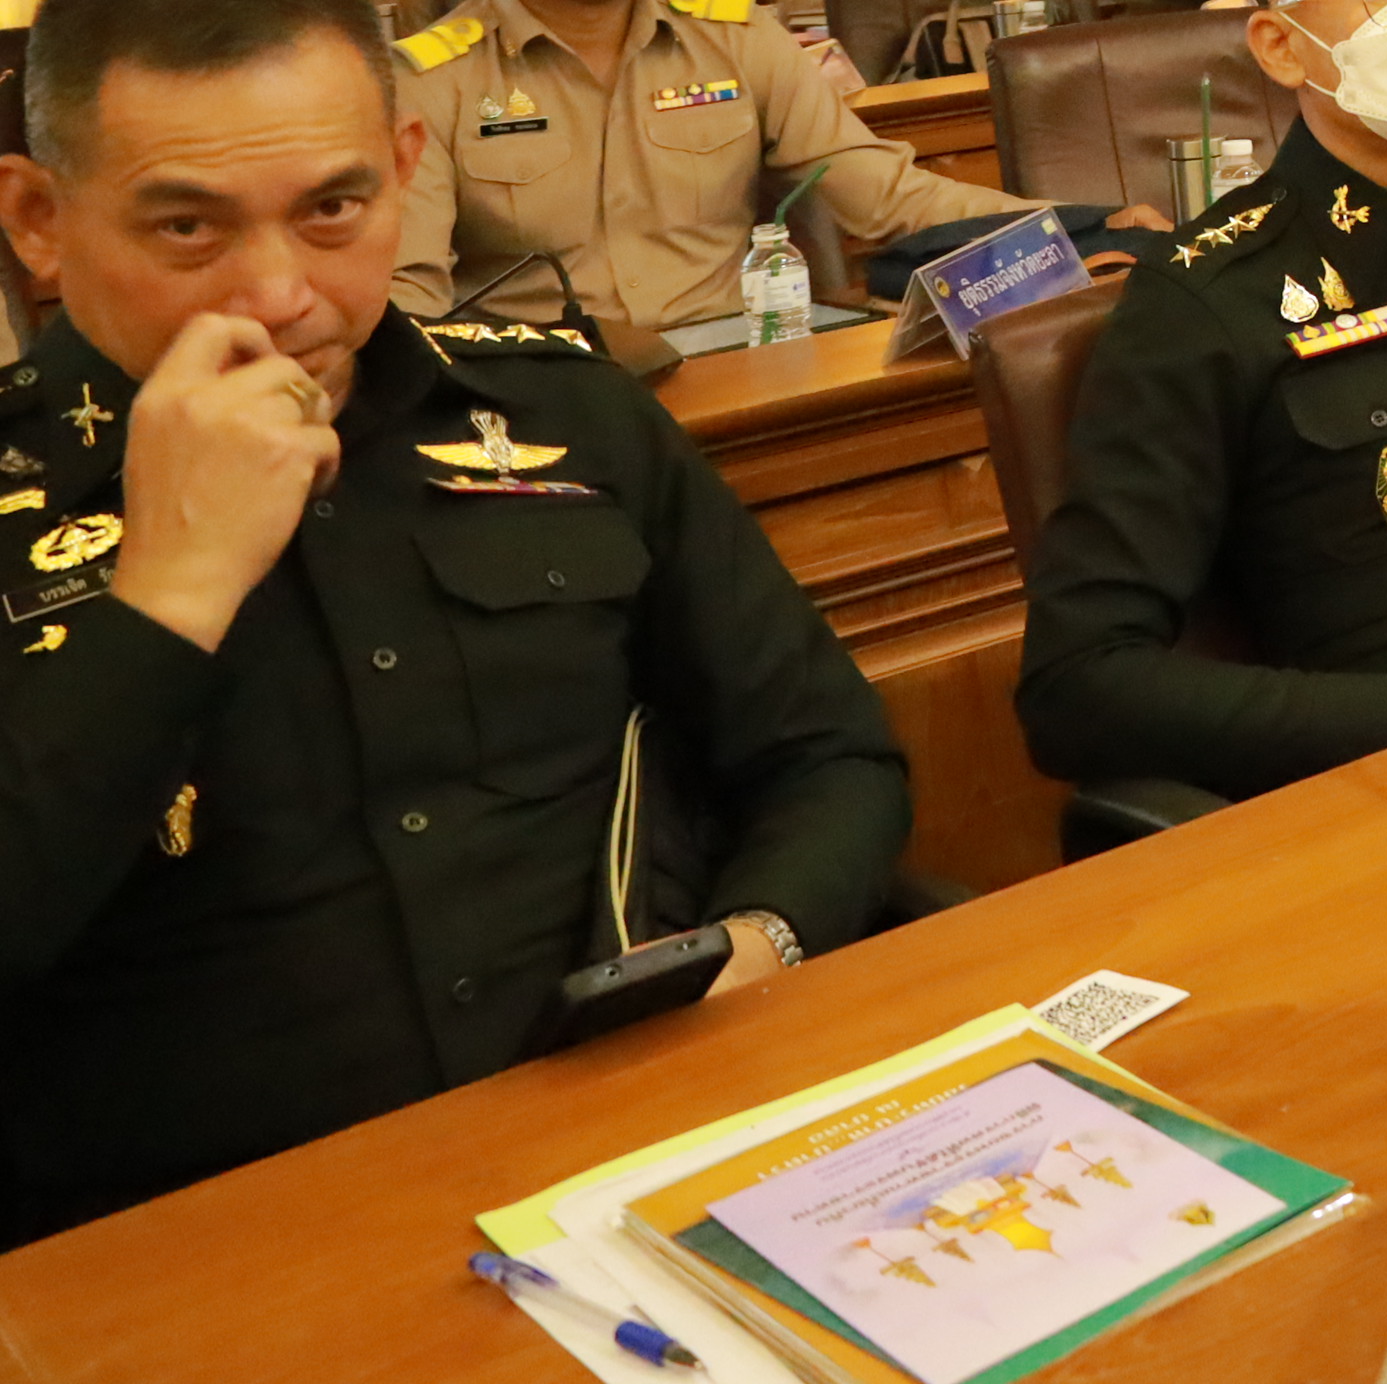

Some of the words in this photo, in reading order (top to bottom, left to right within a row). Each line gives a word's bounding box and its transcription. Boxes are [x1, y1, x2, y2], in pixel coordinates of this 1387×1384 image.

[958, 243, 1065, 317] ยุติธรรมจังหวัดยะลา
